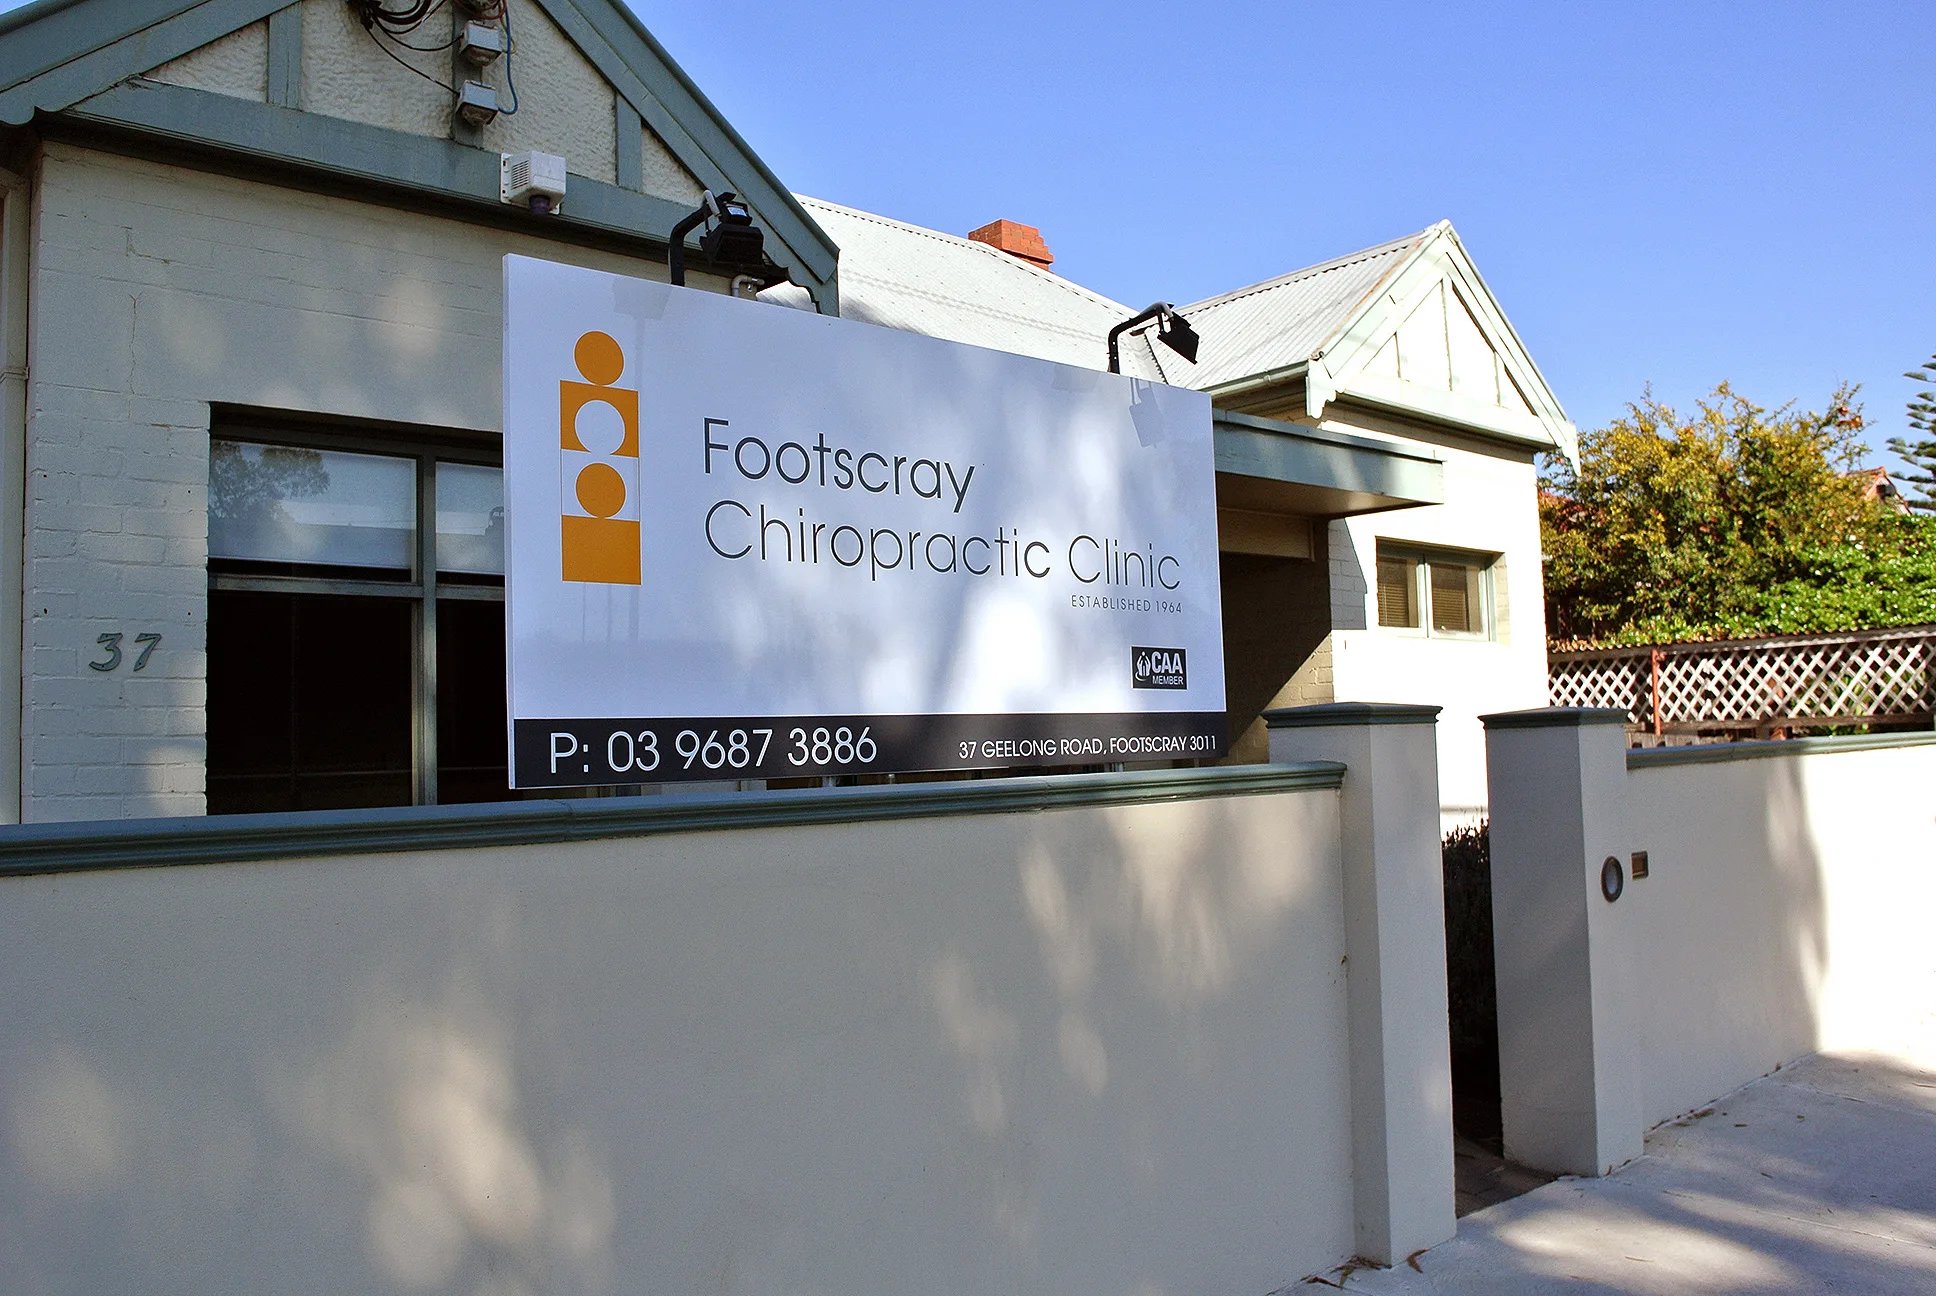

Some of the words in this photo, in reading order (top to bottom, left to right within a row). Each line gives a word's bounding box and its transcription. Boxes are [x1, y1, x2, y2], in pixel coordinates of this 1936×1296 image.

[703, 416, 976, 513] Footscray
[704, 499, 1051, 582] Chiropractic
[1068, 535, 1181, 591] Clinic
[1071, 595, 1151, 612] ESTABLISHED
[1155, 600, 1182, 613] 1964
[89, 632, 162, 672] 37
[1151, 650, 1183, 674] CAA
[1152, 675, 1184, 685] MEMBER
[550, 732, 589, 774] P:
[607, 730, 661, 772] 03
[675, 728, 774, 770] 9687
[787, 726, 877, 766] 3886
[959, 741, 977, 759] 37
[982, 738, 1057, 758] GEELONG
[1060, 738, 1107, 756] ROAD,
[1110, 735, 1187, 754] FOOTSCRAY
[1189, 735, 1216, 751] 3011
